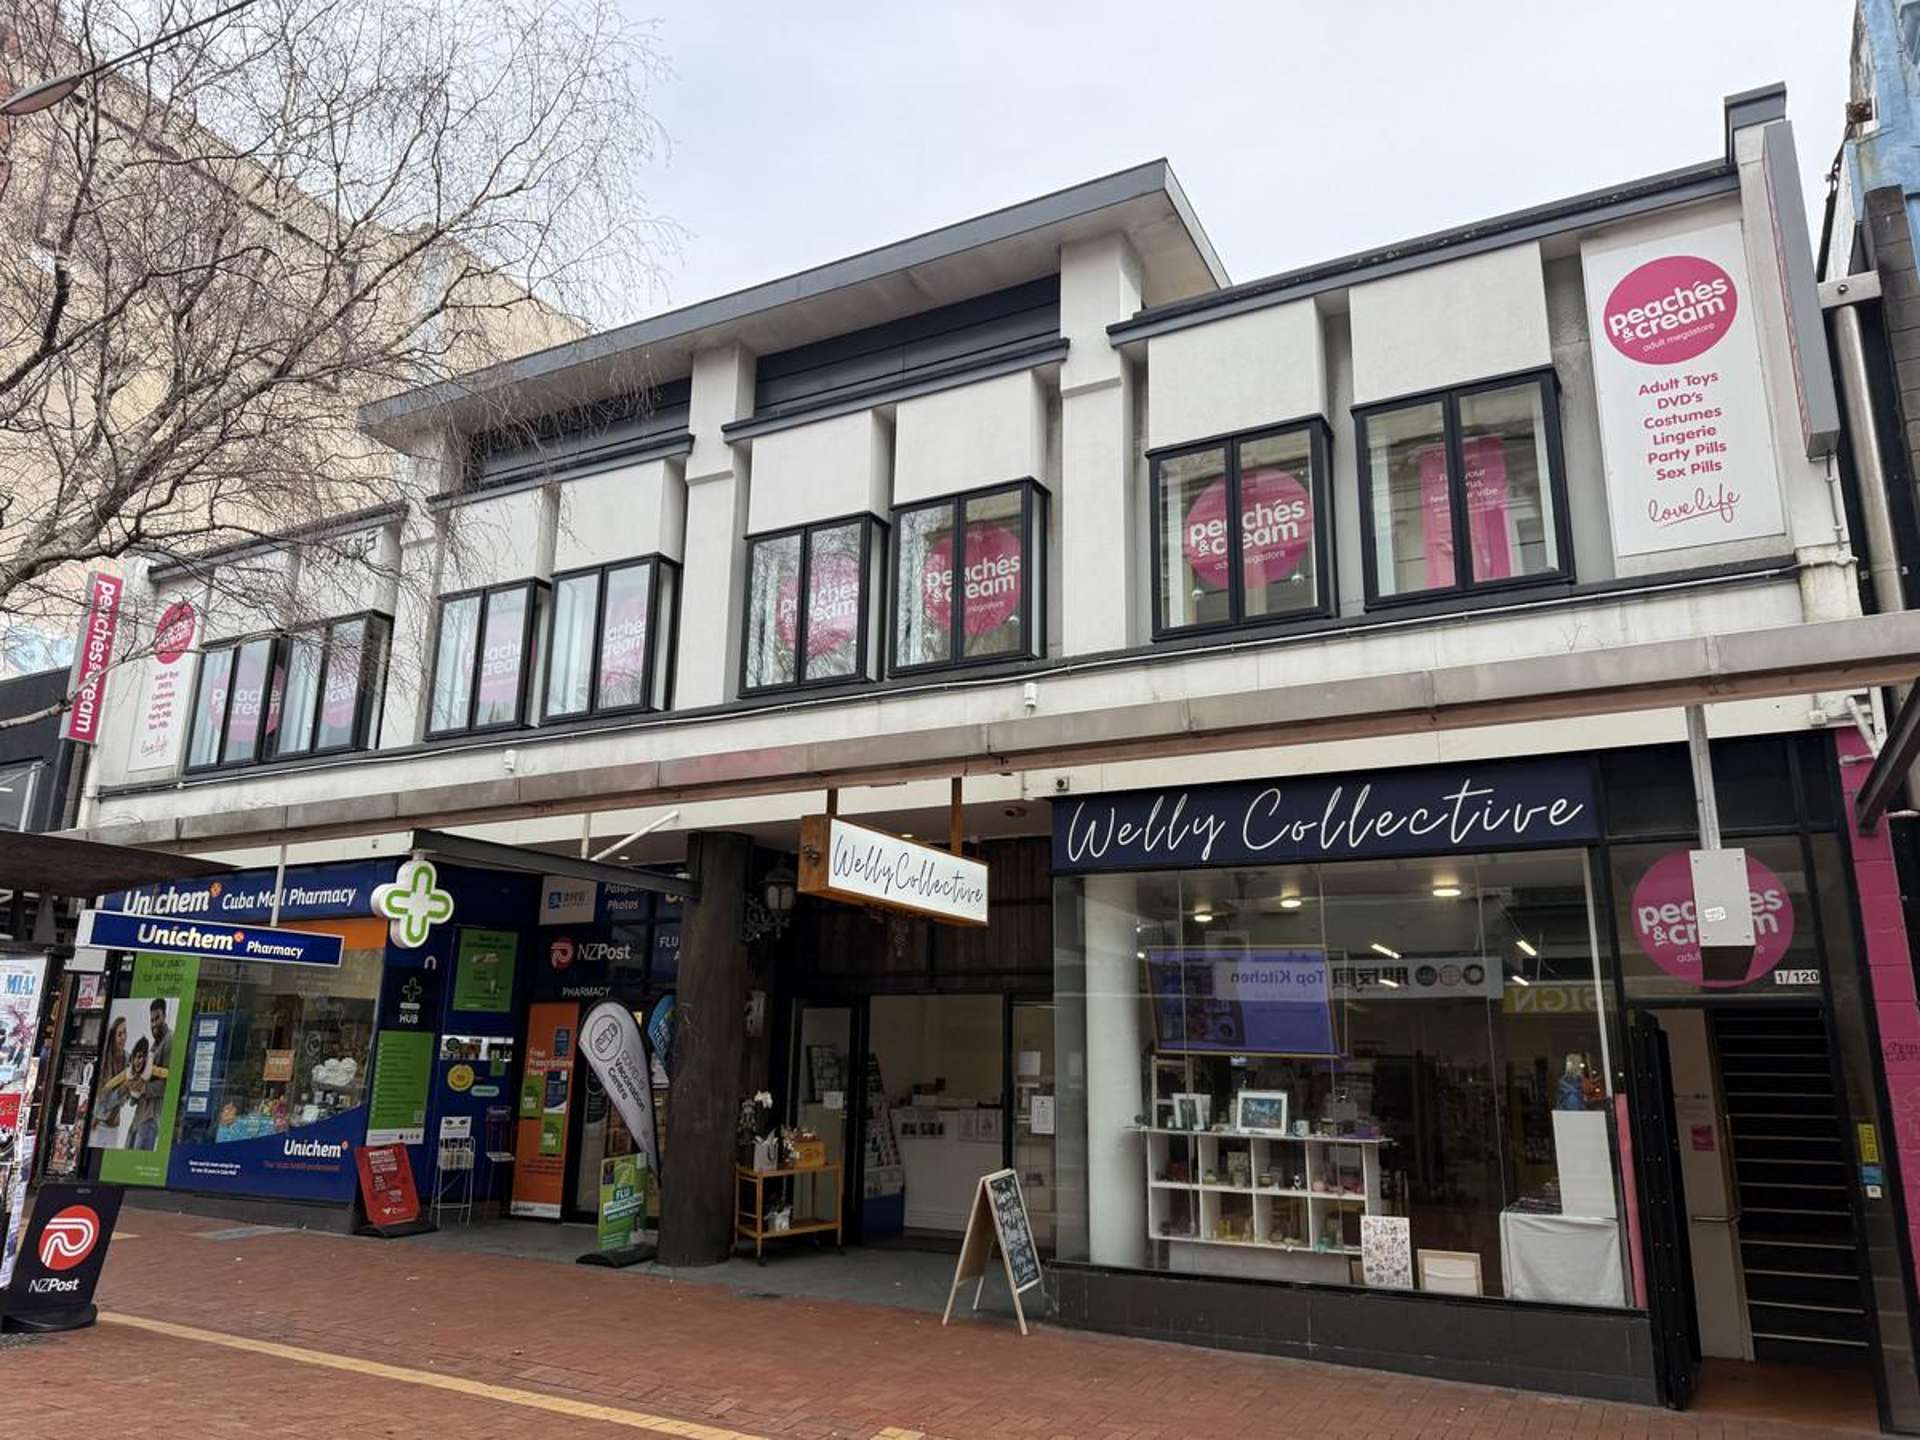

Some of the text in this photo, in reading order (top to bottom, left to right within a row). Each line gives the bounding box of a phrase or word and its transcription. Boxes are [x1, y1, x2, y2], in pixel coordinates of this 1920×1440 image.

[1609, 278, 1728, 337] peachés
[1639, 371, 1719, 396] Adult Toys
[1644, 406, 1722, 430] Costumes
[1652, 425, 1717, 446] Lingerie
[1648, 441, 1727, 465] Party Pills
[1656, 460, 1722, 481] Sex Pills
[1190, 499, 1306, 548] pechés
[1068, 779, 1584, 862] Welly Collective
[833, 834, 984, 906] Welly Collective
[123, 886, 209, 916] Unichem
[222, 892, 254, 911] Cuba
[289, 886, 357, 906] Pharmacy
[607, 899, 640, 911] Photos
[138, 924, 304, 959] Unichem Pharmacy
[577, 943, 632, 961] NZPost
[562, 986, 611, 998] PHARMACY
[284, 1139, 341, 1158] Unichem
[28, 1278, 80, 1293] NZPost
